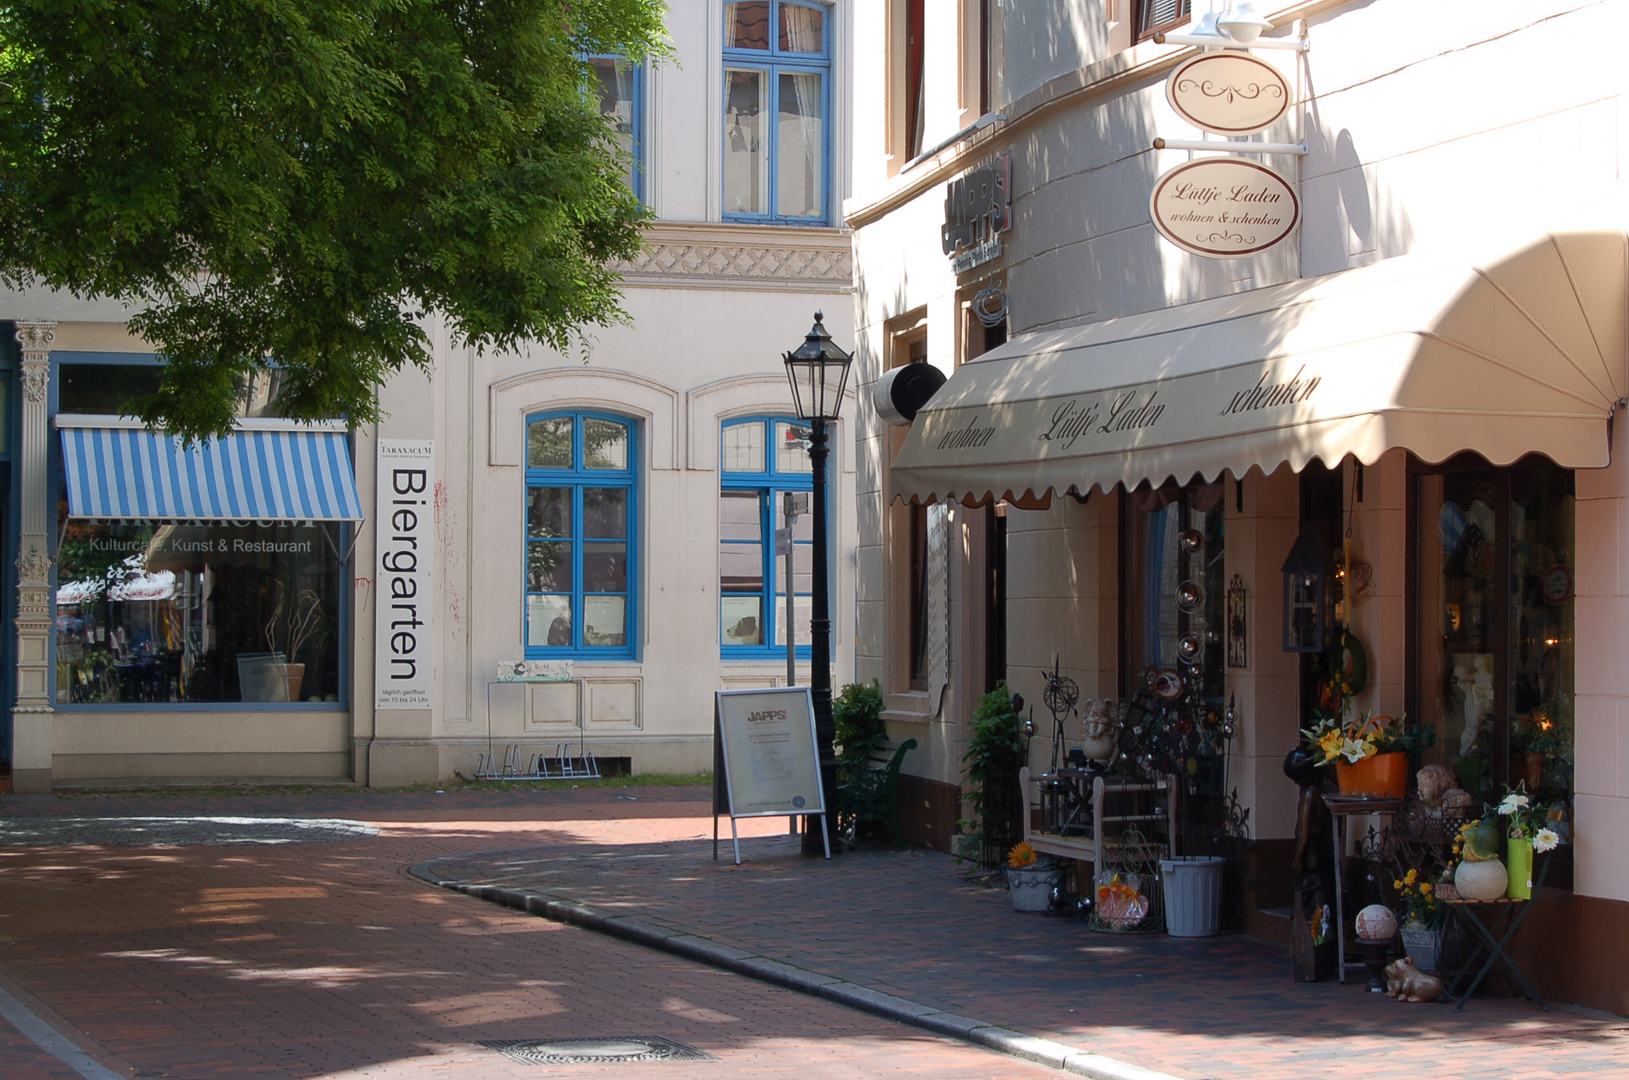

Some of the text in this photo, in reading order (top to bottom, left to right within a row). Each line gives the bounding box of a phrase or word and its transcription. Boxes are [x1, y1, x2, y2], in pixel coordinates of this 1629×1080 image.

[1226, 184, 1281, 204] Laden
[1170, 210, 1281, 226] wohnen & schenken
[937, 415, 996, 450] wohnen
[1096, 390, 1166, 435] Laden
[1218, 364, 1322, 417] schenken
[89, 538, 312, 553] Kulturcae, Kunst & Restaurant
[382, 469, 427, 680] Biergarten
